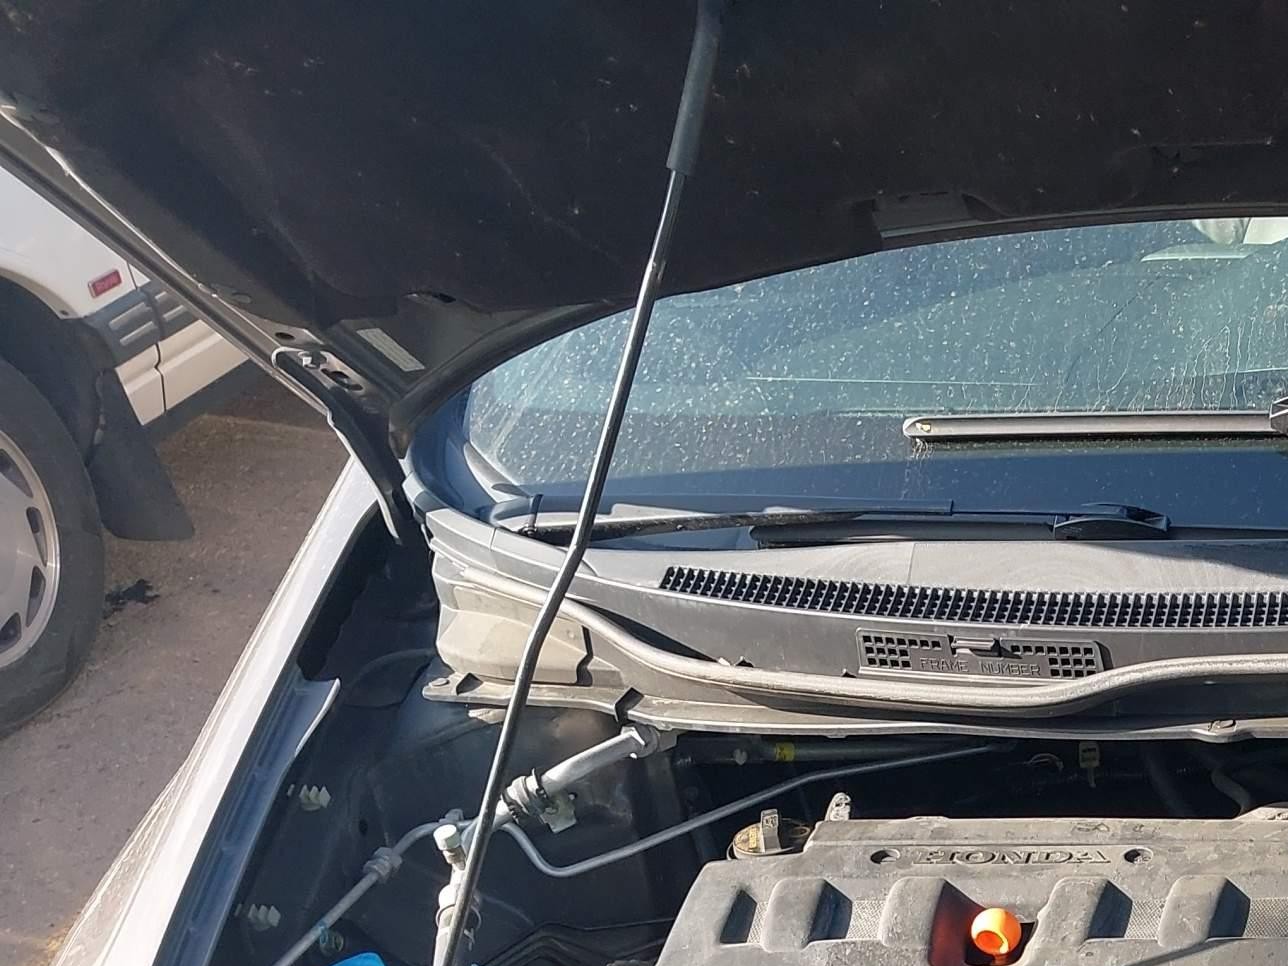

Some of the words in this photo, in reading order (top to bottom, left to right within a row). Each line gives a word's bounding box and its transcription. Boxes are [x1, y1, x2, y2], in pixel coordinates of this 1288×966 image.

[920, 658, 968, 672] FRAME
[979, 660, 1041, 676] NUMBER
[912, 848, 1111, 865] HONDA
